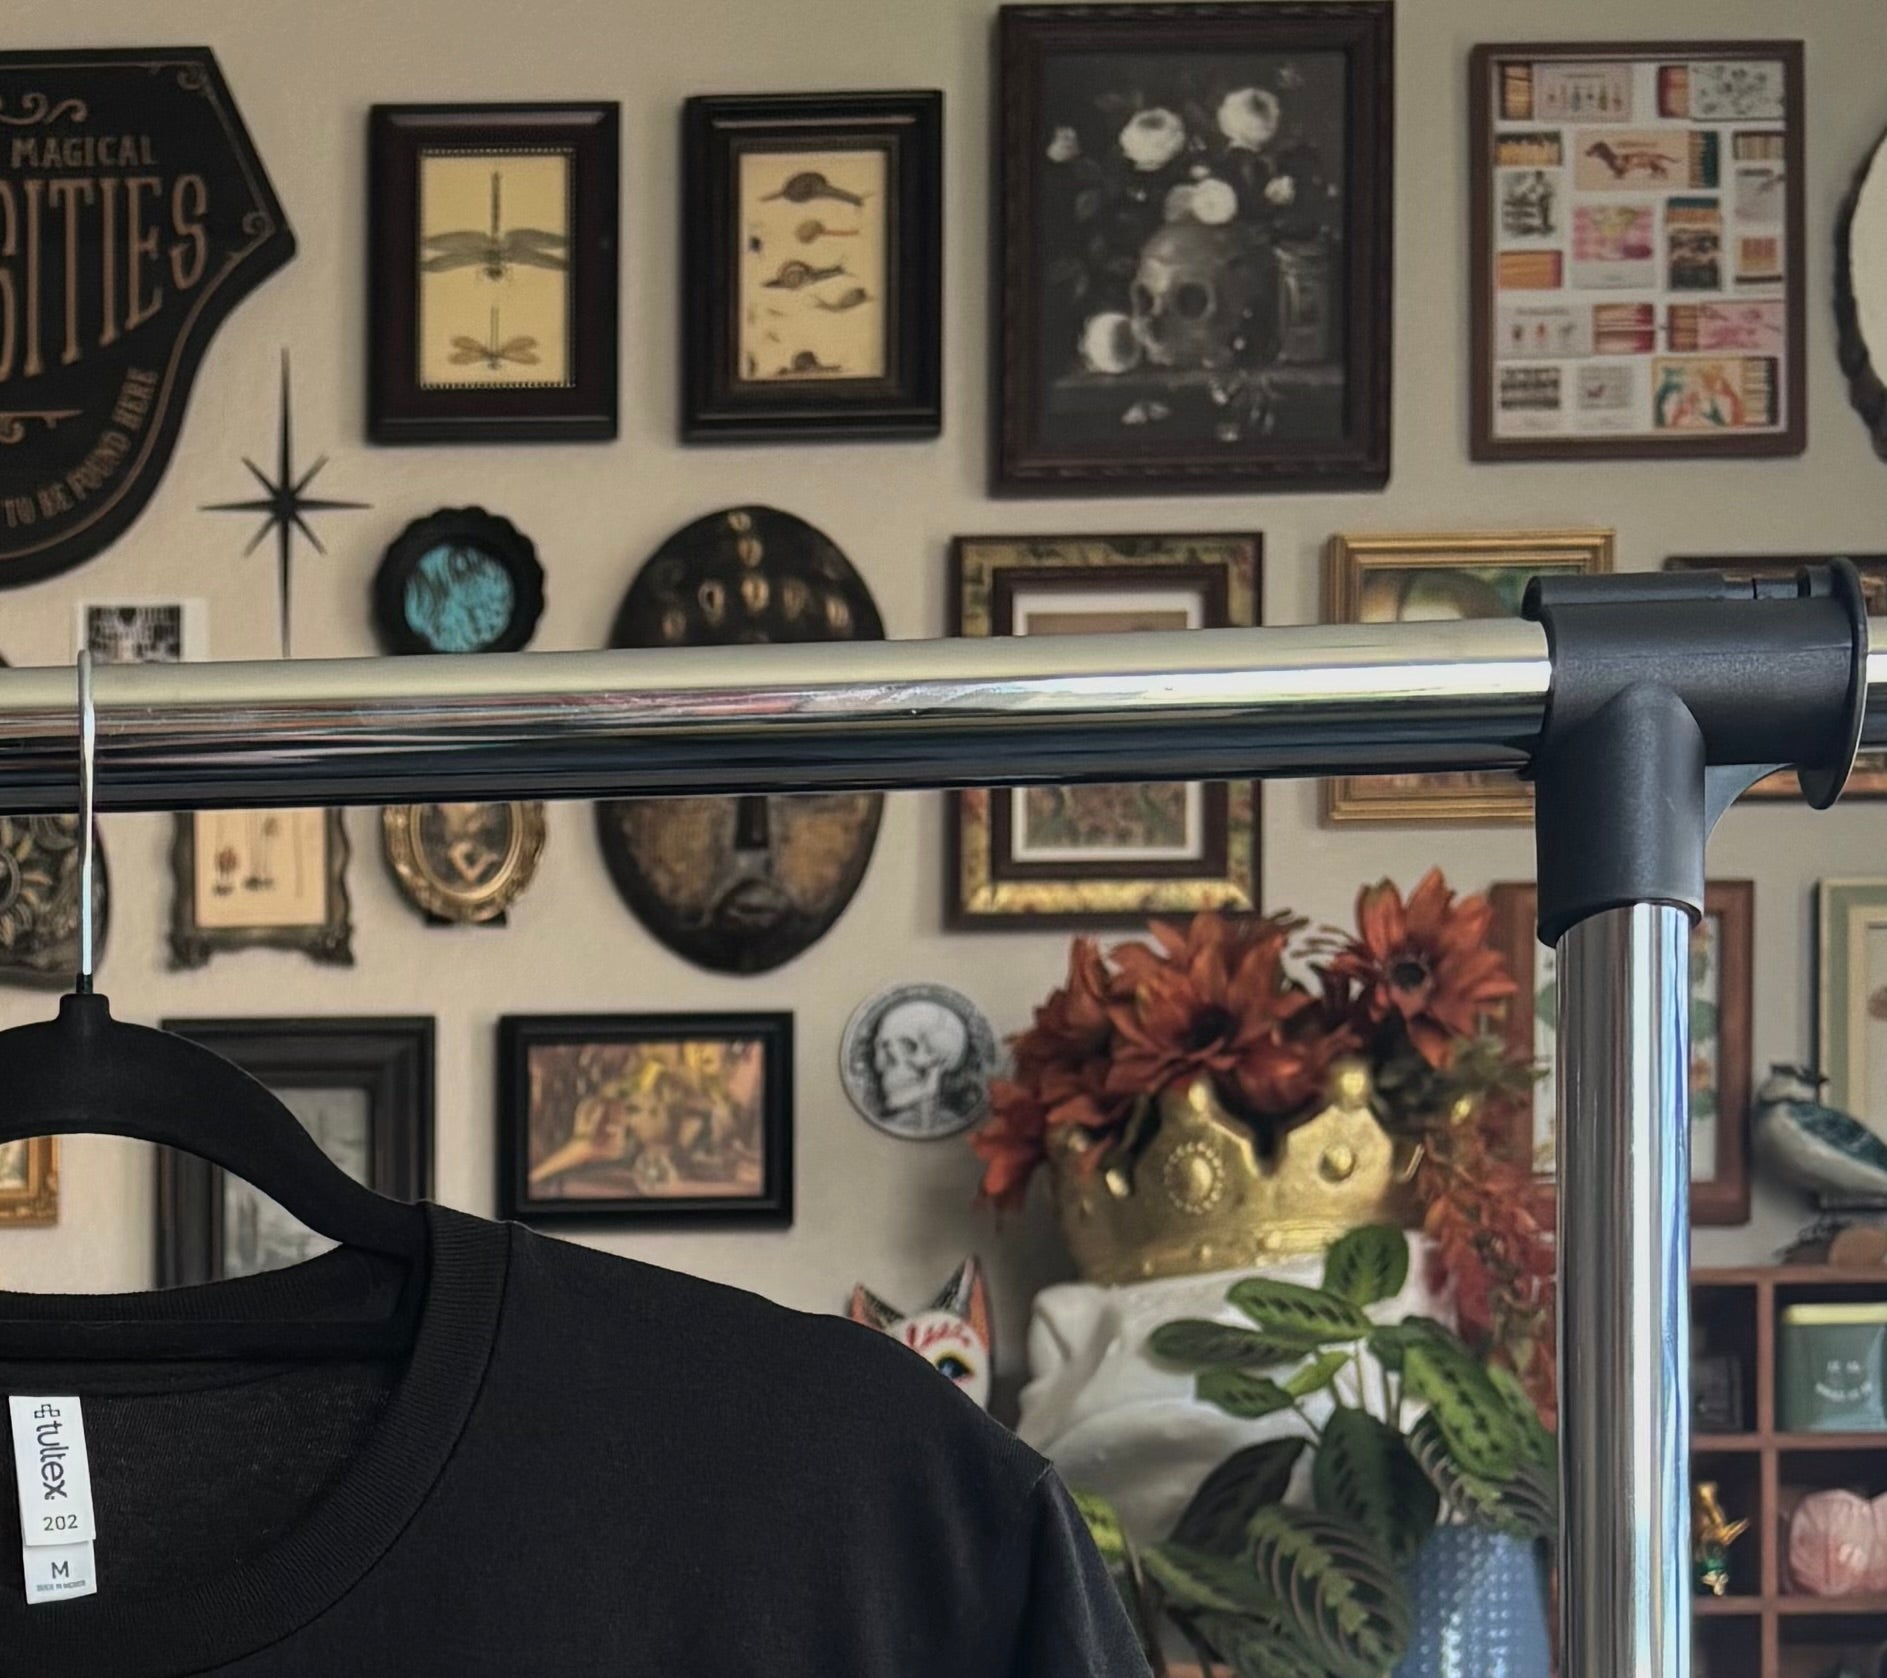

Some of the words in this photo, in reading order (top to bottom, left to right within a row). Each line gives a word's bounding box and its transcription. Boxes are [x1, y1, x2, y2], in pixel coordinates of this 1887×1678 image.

[14, 135, 158, 168] MAGICAL
[43, 1513, 79, 1532] 202
[51, 1560, 69, 1579] M
